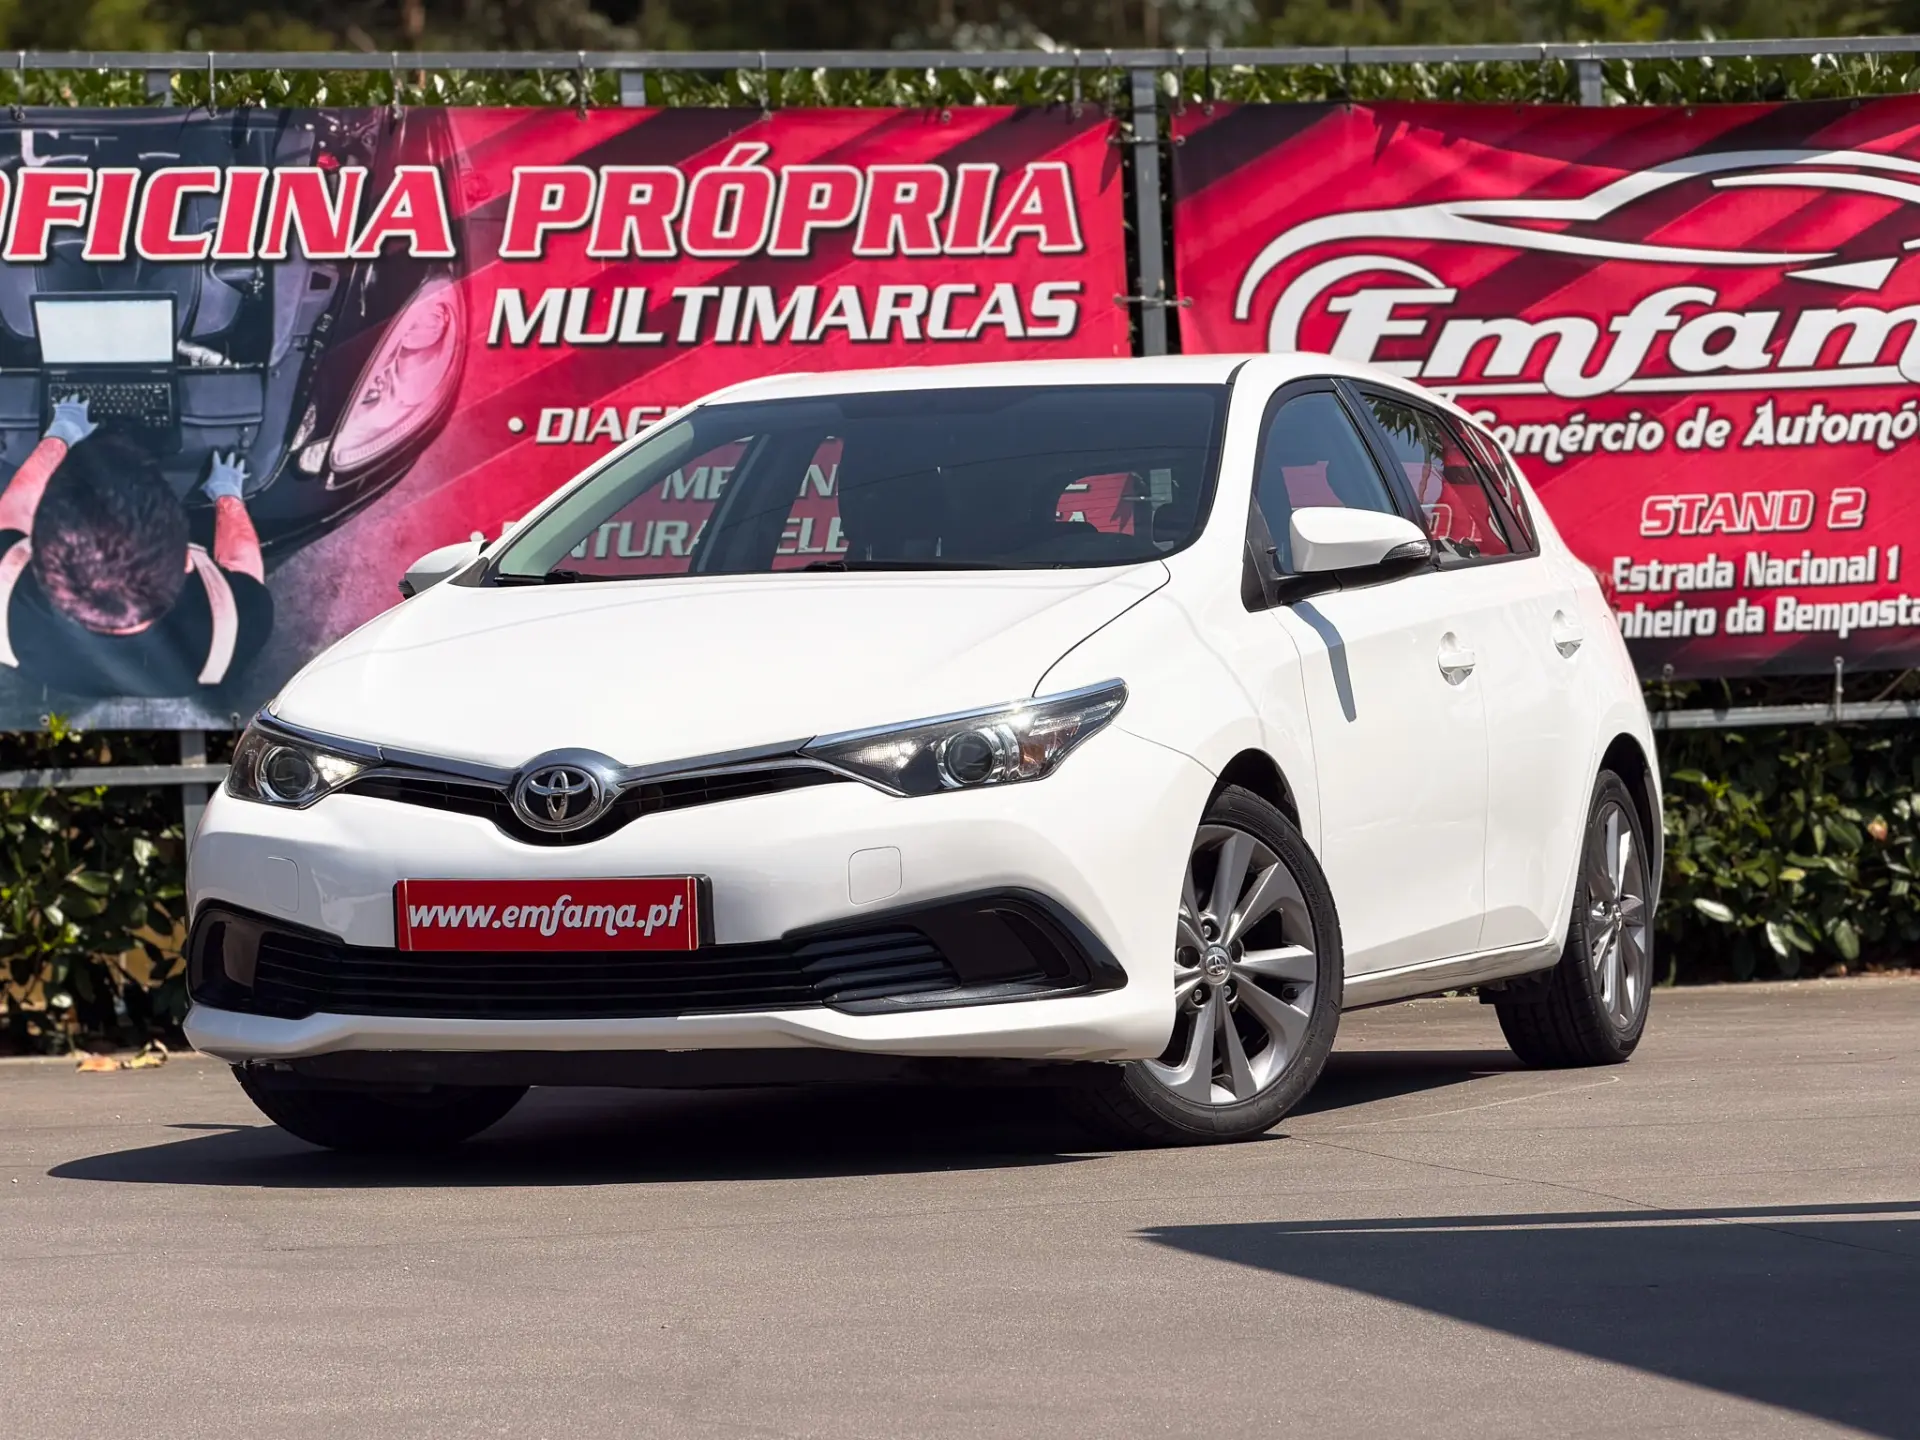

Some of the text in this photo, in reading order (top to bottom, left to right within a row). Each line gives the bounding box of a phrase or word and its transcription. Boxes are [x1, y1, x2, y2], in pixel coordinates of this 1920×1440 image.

[0, 141, 1084, 261] FICINA PRÓPRIA
[487, 281, 1082, 345] MULTIMARCAS
[535, 406, 682, 443] DIAG
[1676, 407, 1732, 450] de
[1742, 398, 1920, 450] Automó
[1639, 487, 1868, 537] STAND 2
[1613, 544, 1900, 592] Estrada Nacional 1
[1616, 600, 1717, 638] nheiro
[1725, 597, 1765, 634] da
[409, 894, 684, 937] www.emfama.pt
